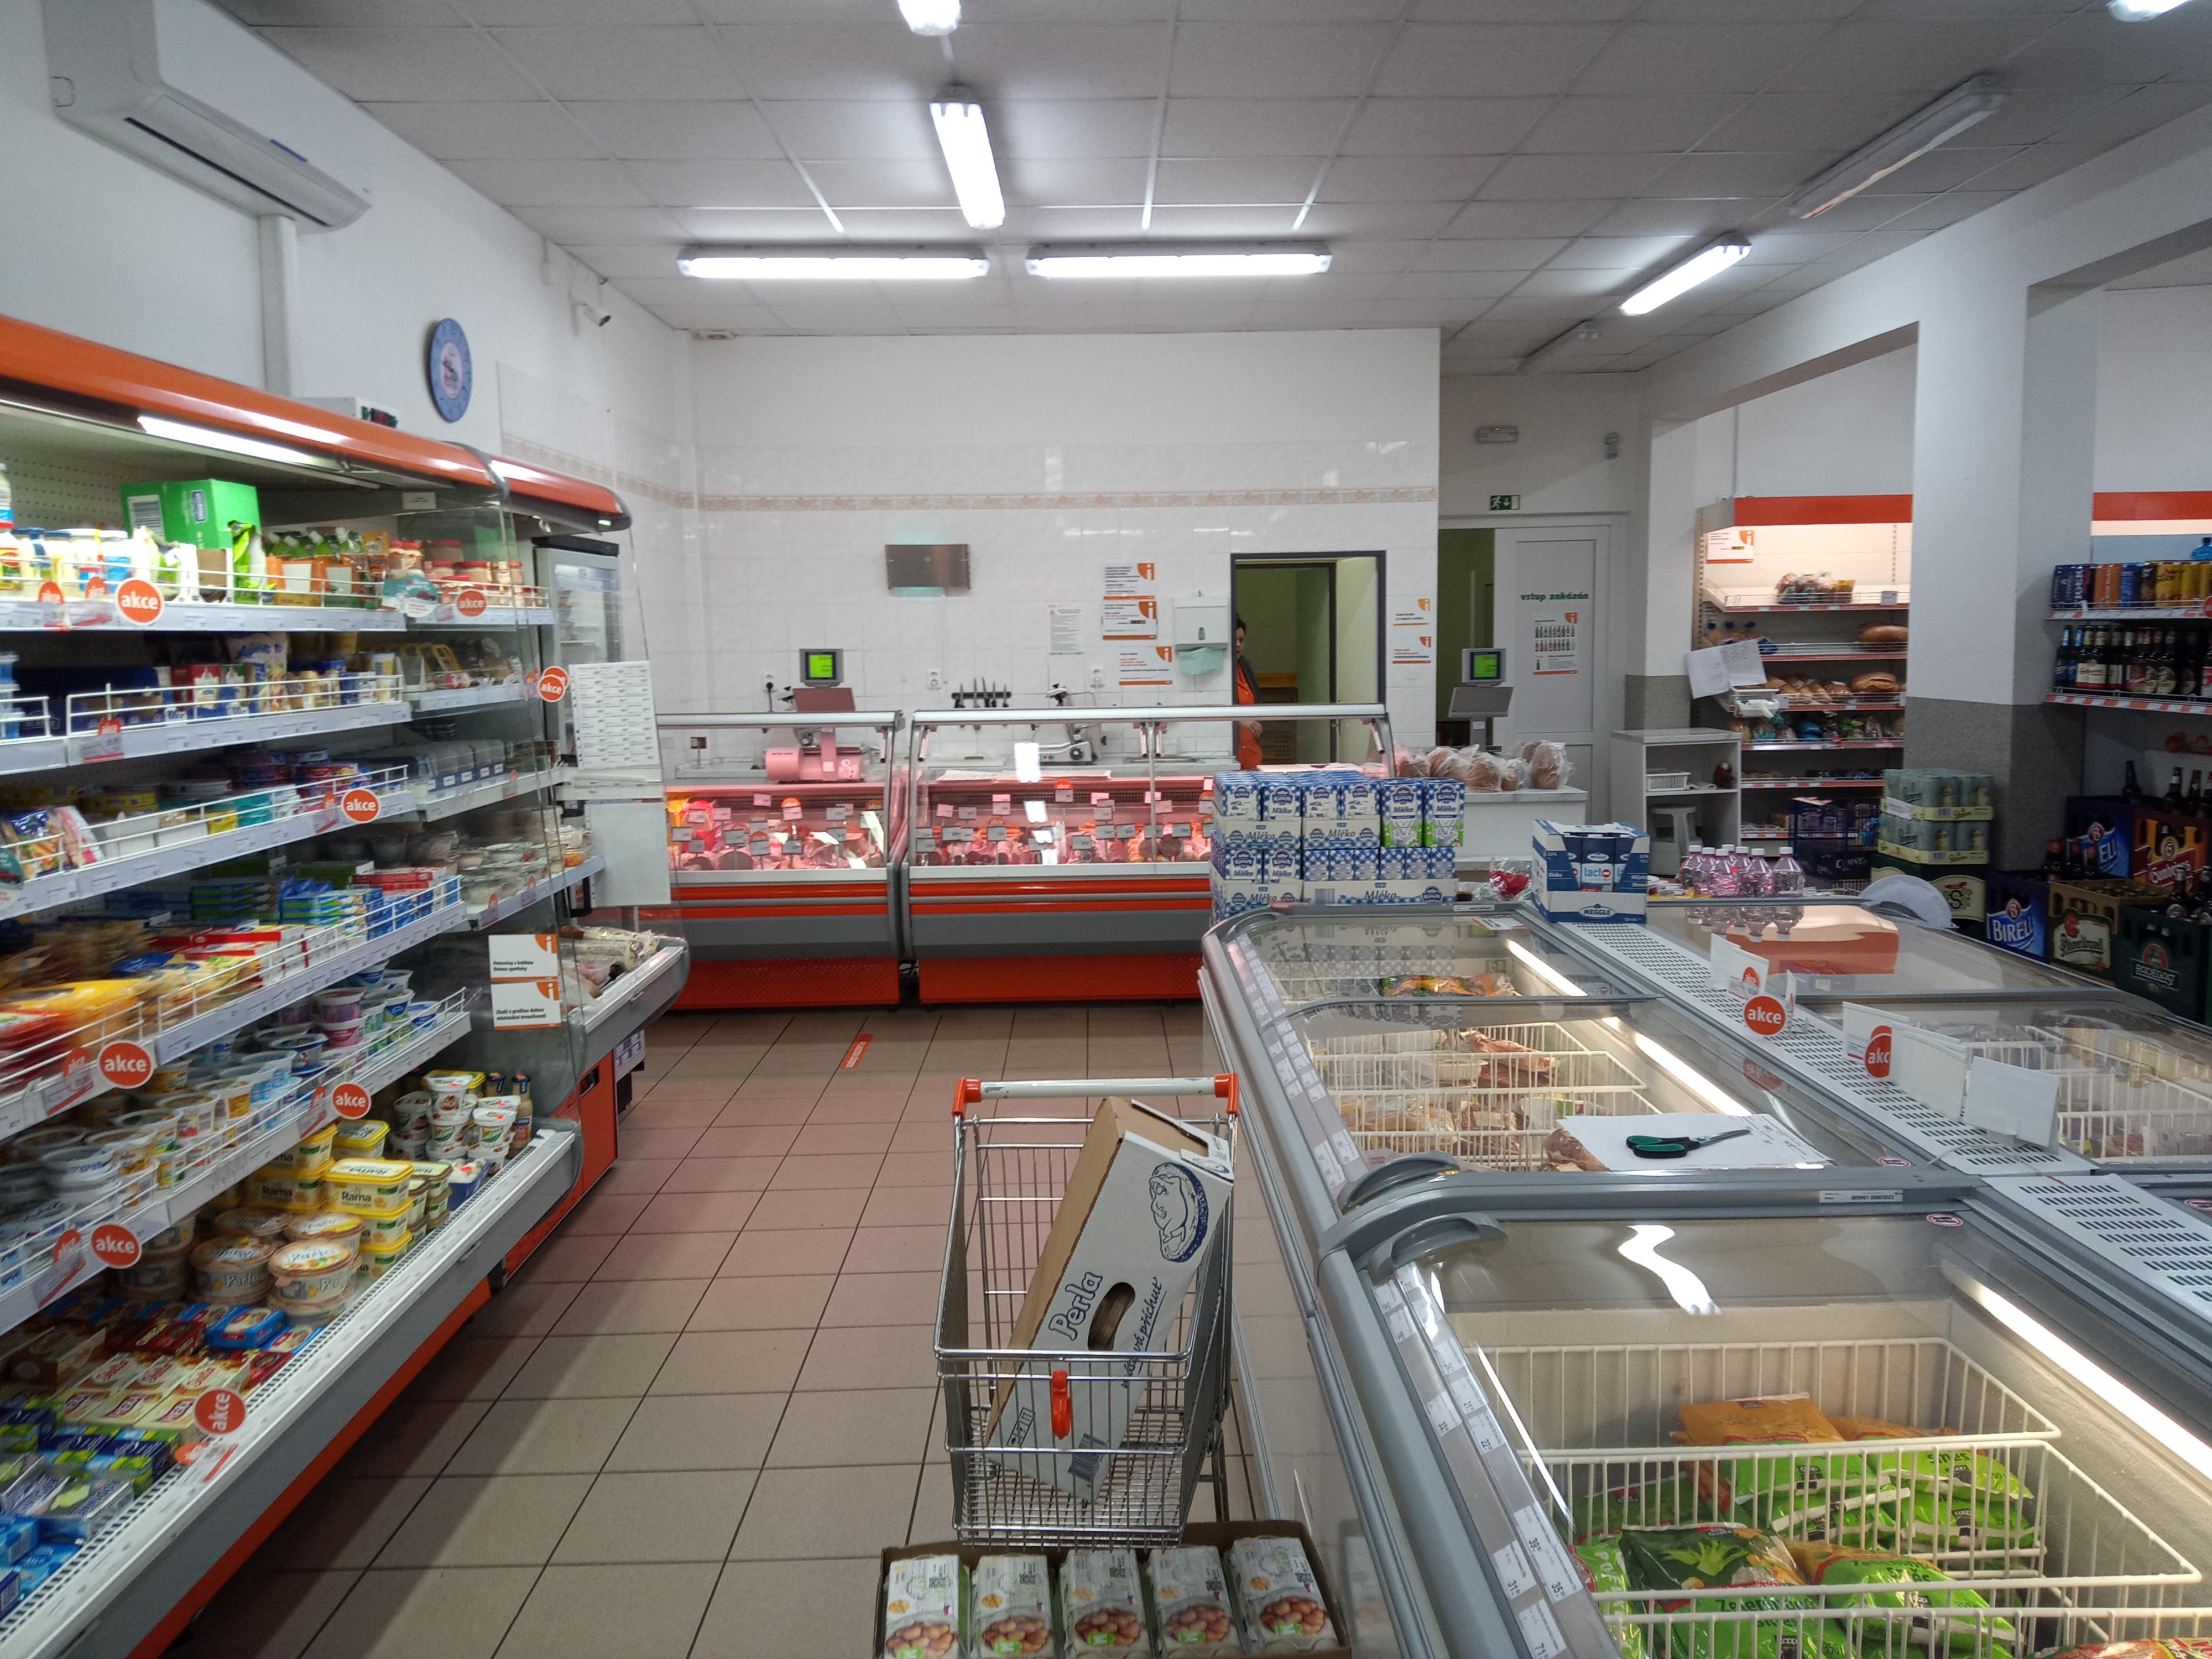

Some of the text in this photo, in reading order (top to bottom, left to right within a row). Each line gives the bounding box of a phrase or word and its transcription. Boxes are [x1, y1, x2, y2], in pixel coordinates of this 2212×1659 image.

[121, 591, 159, 610] akce
[458, 595, 485, 611] akce
[1521, 593, 1546, 602] vstup
[540, 680, 562, 695] akce
[345, 797, 377, 812] akce
[1272, 806, 1292, 815] Mléko
[1248, 831, 1275, 841] Mléko
[1328, 829, 1356, 838] Mléko
[1250, 893, 1277, 902] Mléko
[1364, 890, 1397, 900] Mléko
[1992, 916, 2033, 942] BIRELL
[1747, 1006, 1782, 1024] akce
[103, 1053, 148, 1073] akce
[1868, 1047, 1891, 1065] akc
[335, 1092, 367, 1108] akce
[341, 1190, 372, 1202] Rama
[95, 1236, 135, 1255] akce
[1048, 1271, 1103, 1342] Perla
[1139, 1276, 1162, 1338] příchuť
[208, 1392, 231, 1432] akce
[1480, 1438, 1491, 1451] 22
[1528, 1537, 1540, 1548] 39
[1507, 1579, 1517, 1592] 31
[1551, 1582, 1563, 1594] 35
